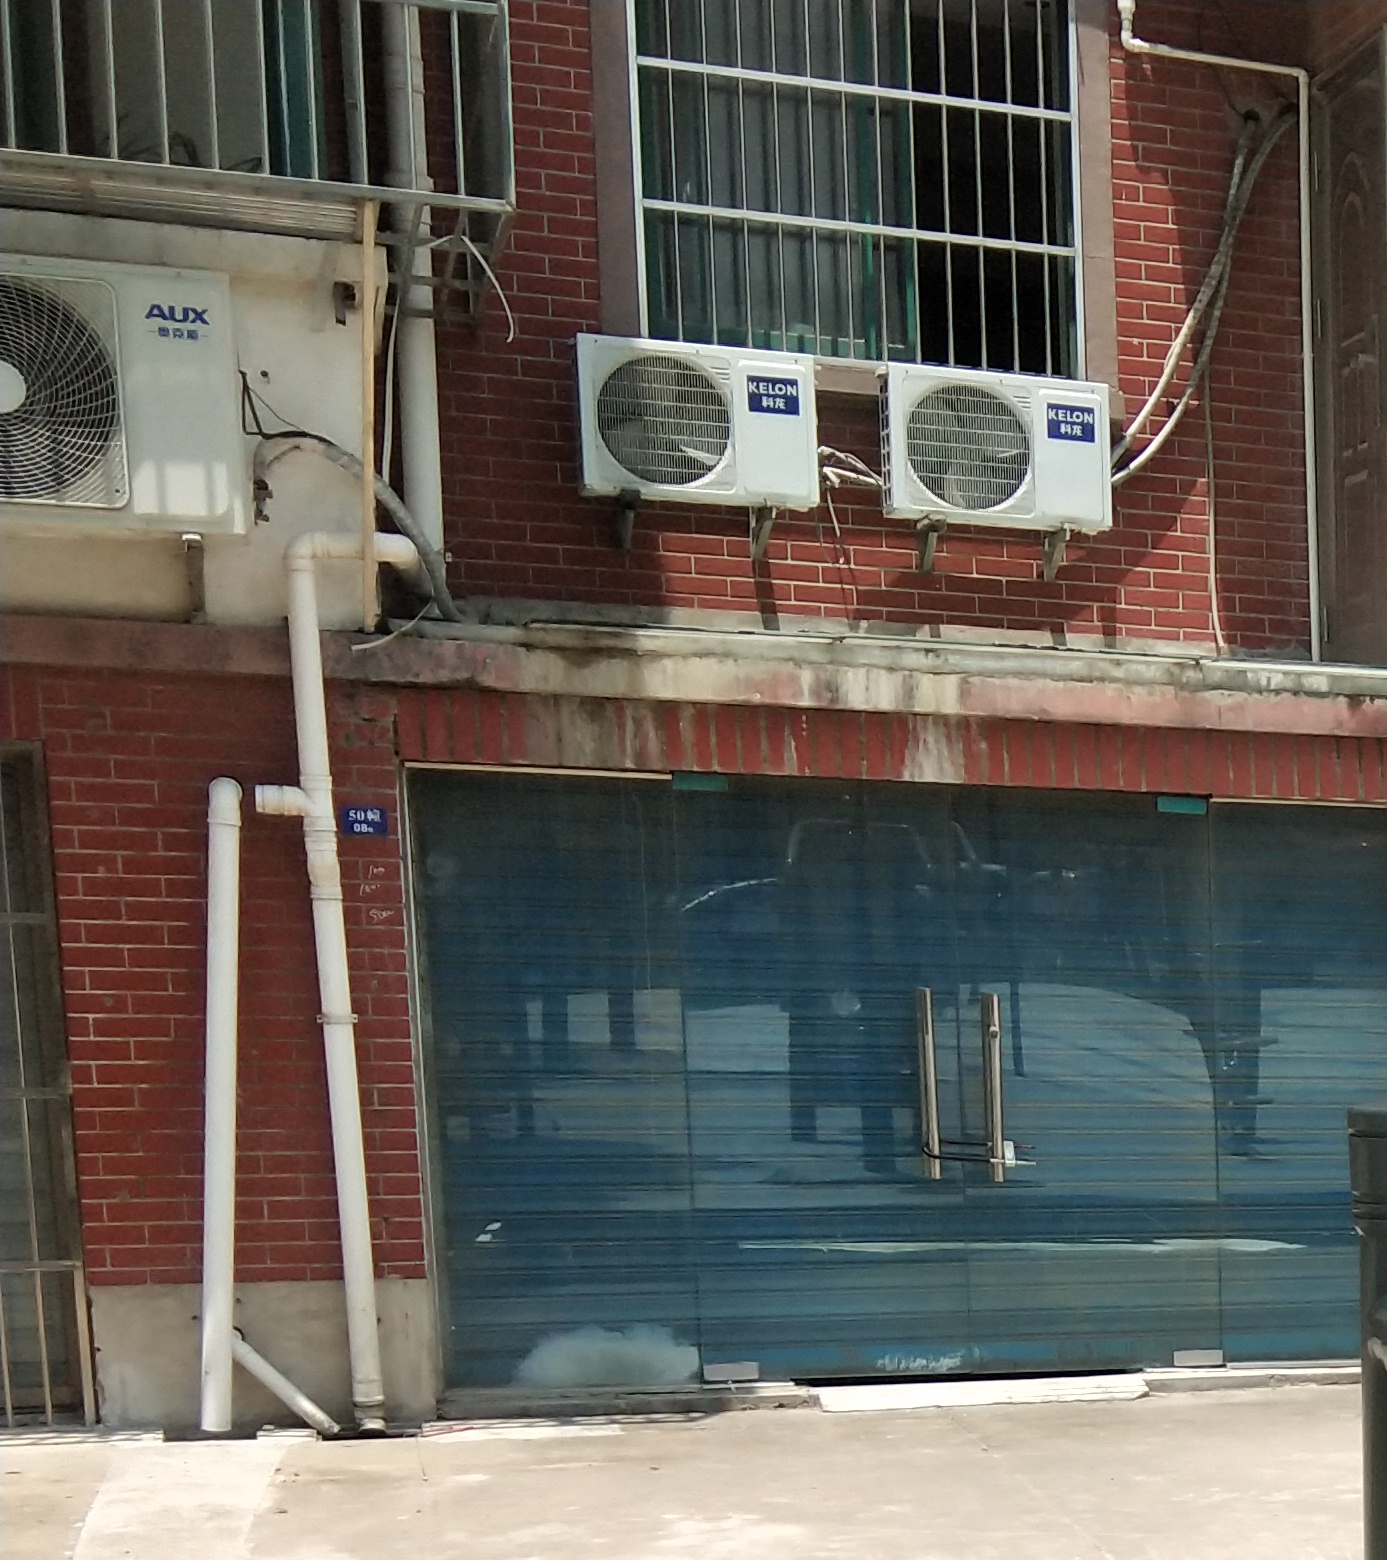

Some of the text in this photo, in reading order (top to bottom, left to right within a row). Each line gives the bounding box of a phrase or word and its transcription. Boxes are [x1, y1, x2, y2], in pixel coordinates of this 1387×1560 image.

[145, 303, 211, 326] AUX
[748, 381, 797, 397] KELON
[1047, 407, 1094, 425] KELON
